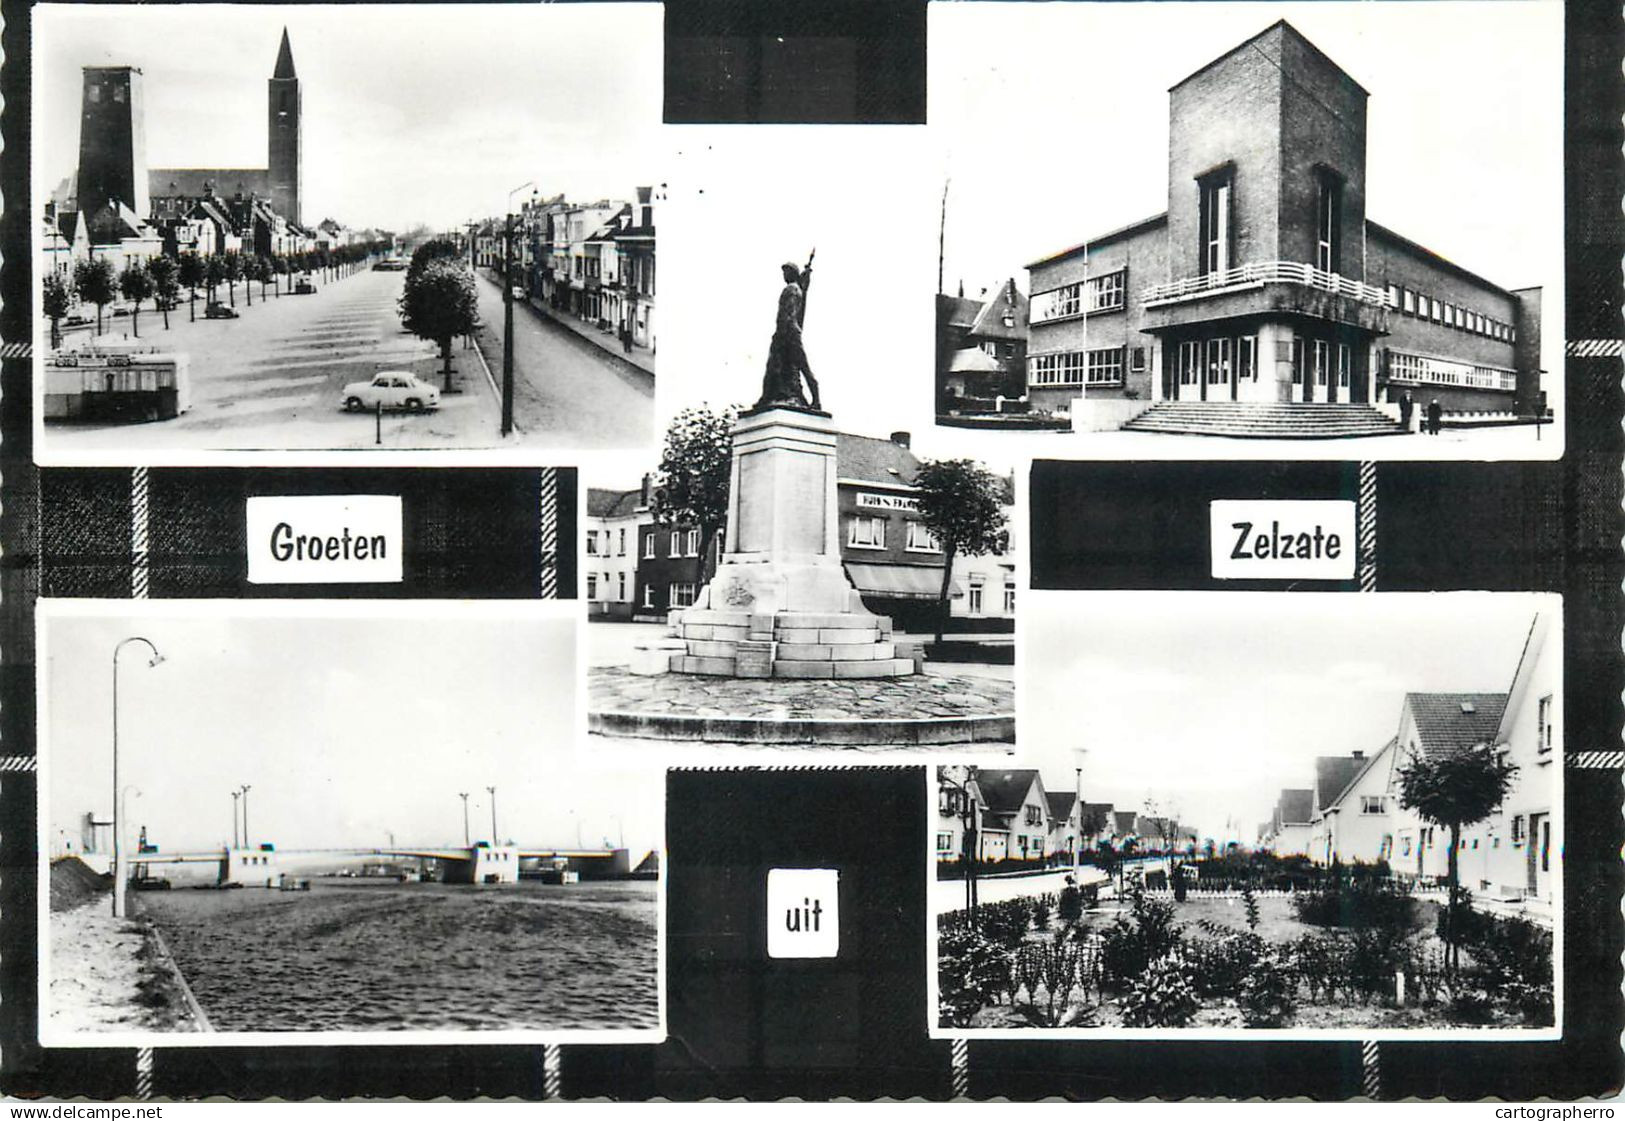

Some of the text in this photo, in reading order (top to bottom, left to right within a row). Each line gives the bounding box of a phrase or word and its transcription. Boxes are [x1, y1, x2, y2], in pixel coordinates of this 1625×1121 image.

[270, 522, 386, 562] Groeten
[1230, 520, 1341, 560] Zelzate
[786, 897, 823, 932] uit
